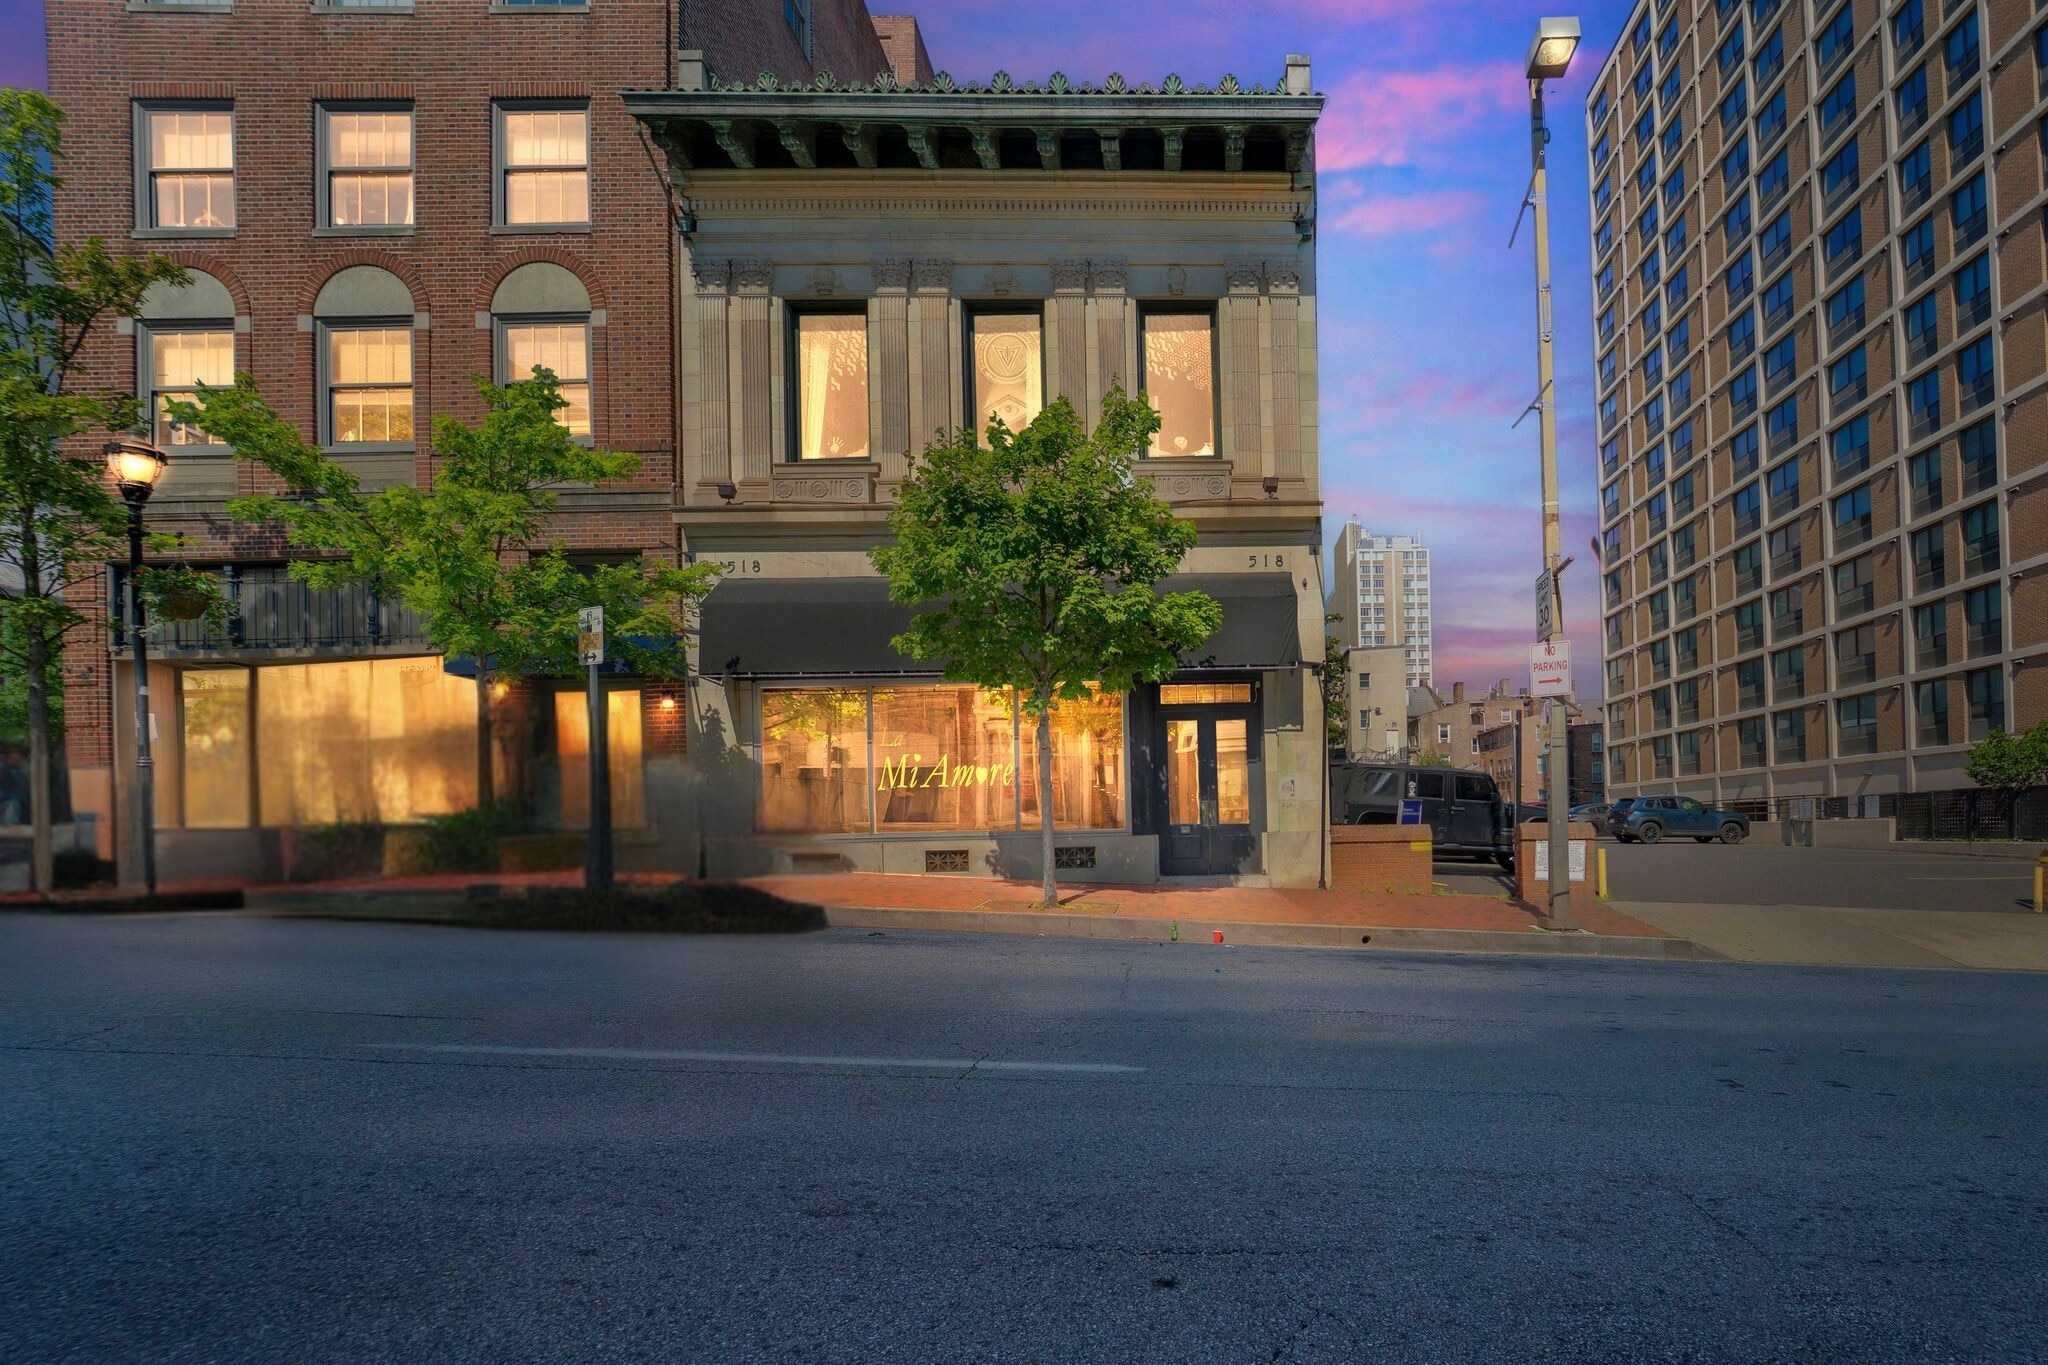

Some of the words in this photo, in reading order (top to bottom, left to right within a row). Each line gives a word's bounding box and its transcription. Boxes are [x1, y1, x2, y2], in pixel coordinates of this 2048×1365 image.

[727, 559, 761, 574] 518
[1248, 553, 1284, 568] 518
[1539, 605, 1550, 627] 30
[1544, 645, 1556, 657] NO
[1533, 660, 1568, 673] PARKING
[880, 726, 904, 747] La
[877, 753, 922, 791] Mi
